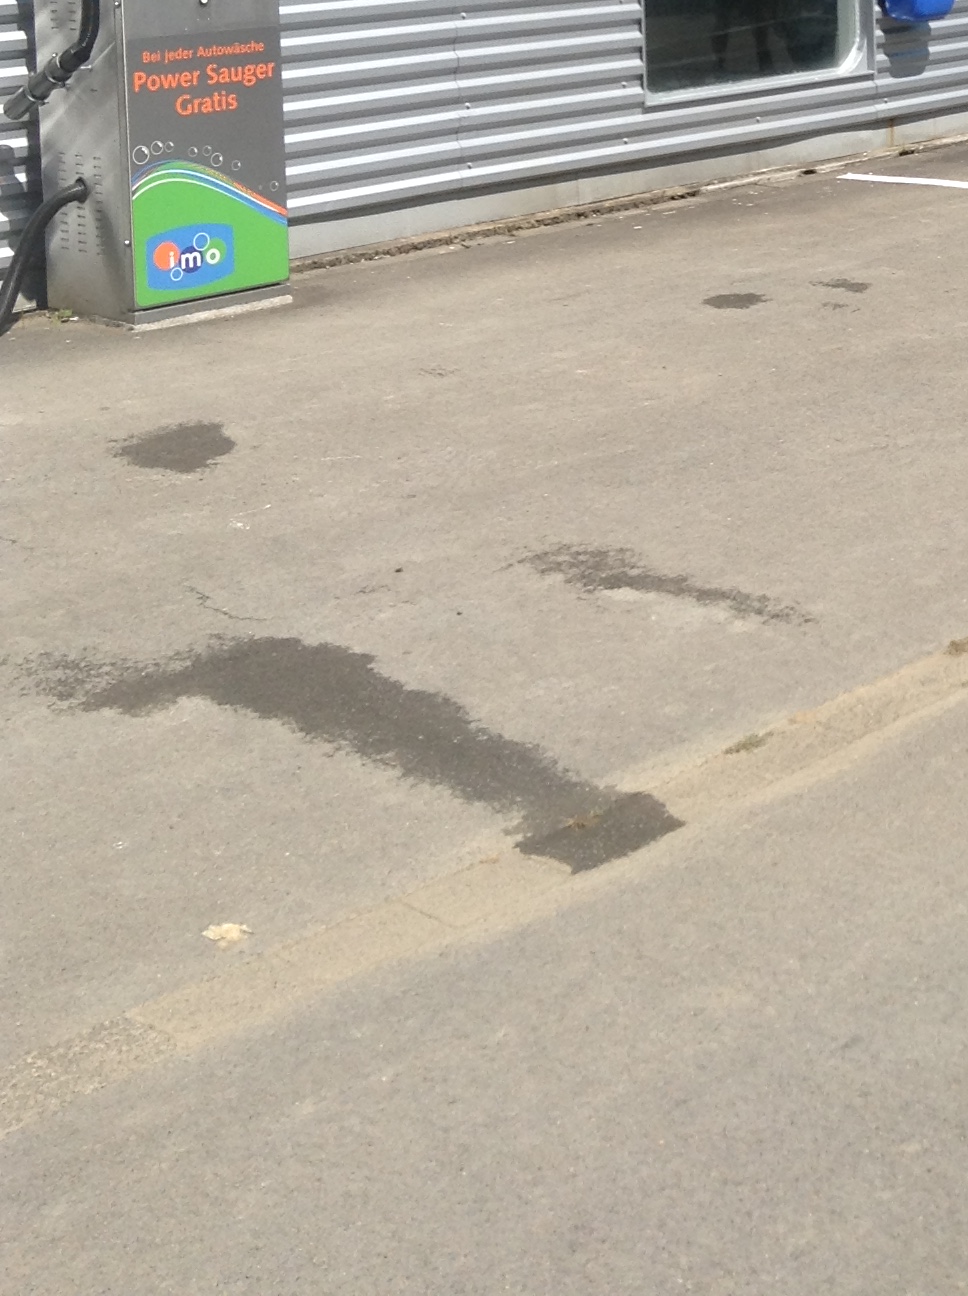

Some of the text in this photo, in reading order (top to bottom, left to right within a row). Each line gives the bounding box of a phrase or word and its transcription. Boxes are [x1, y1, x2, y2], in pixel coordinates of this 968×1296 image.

[142, 40, 265, 64] Bei jeder Autowäsche
[133, 62, 275, 93] Power Sauger
[175, 90, 238, 116] Gratis
[168, 248, 221, 270] imo
